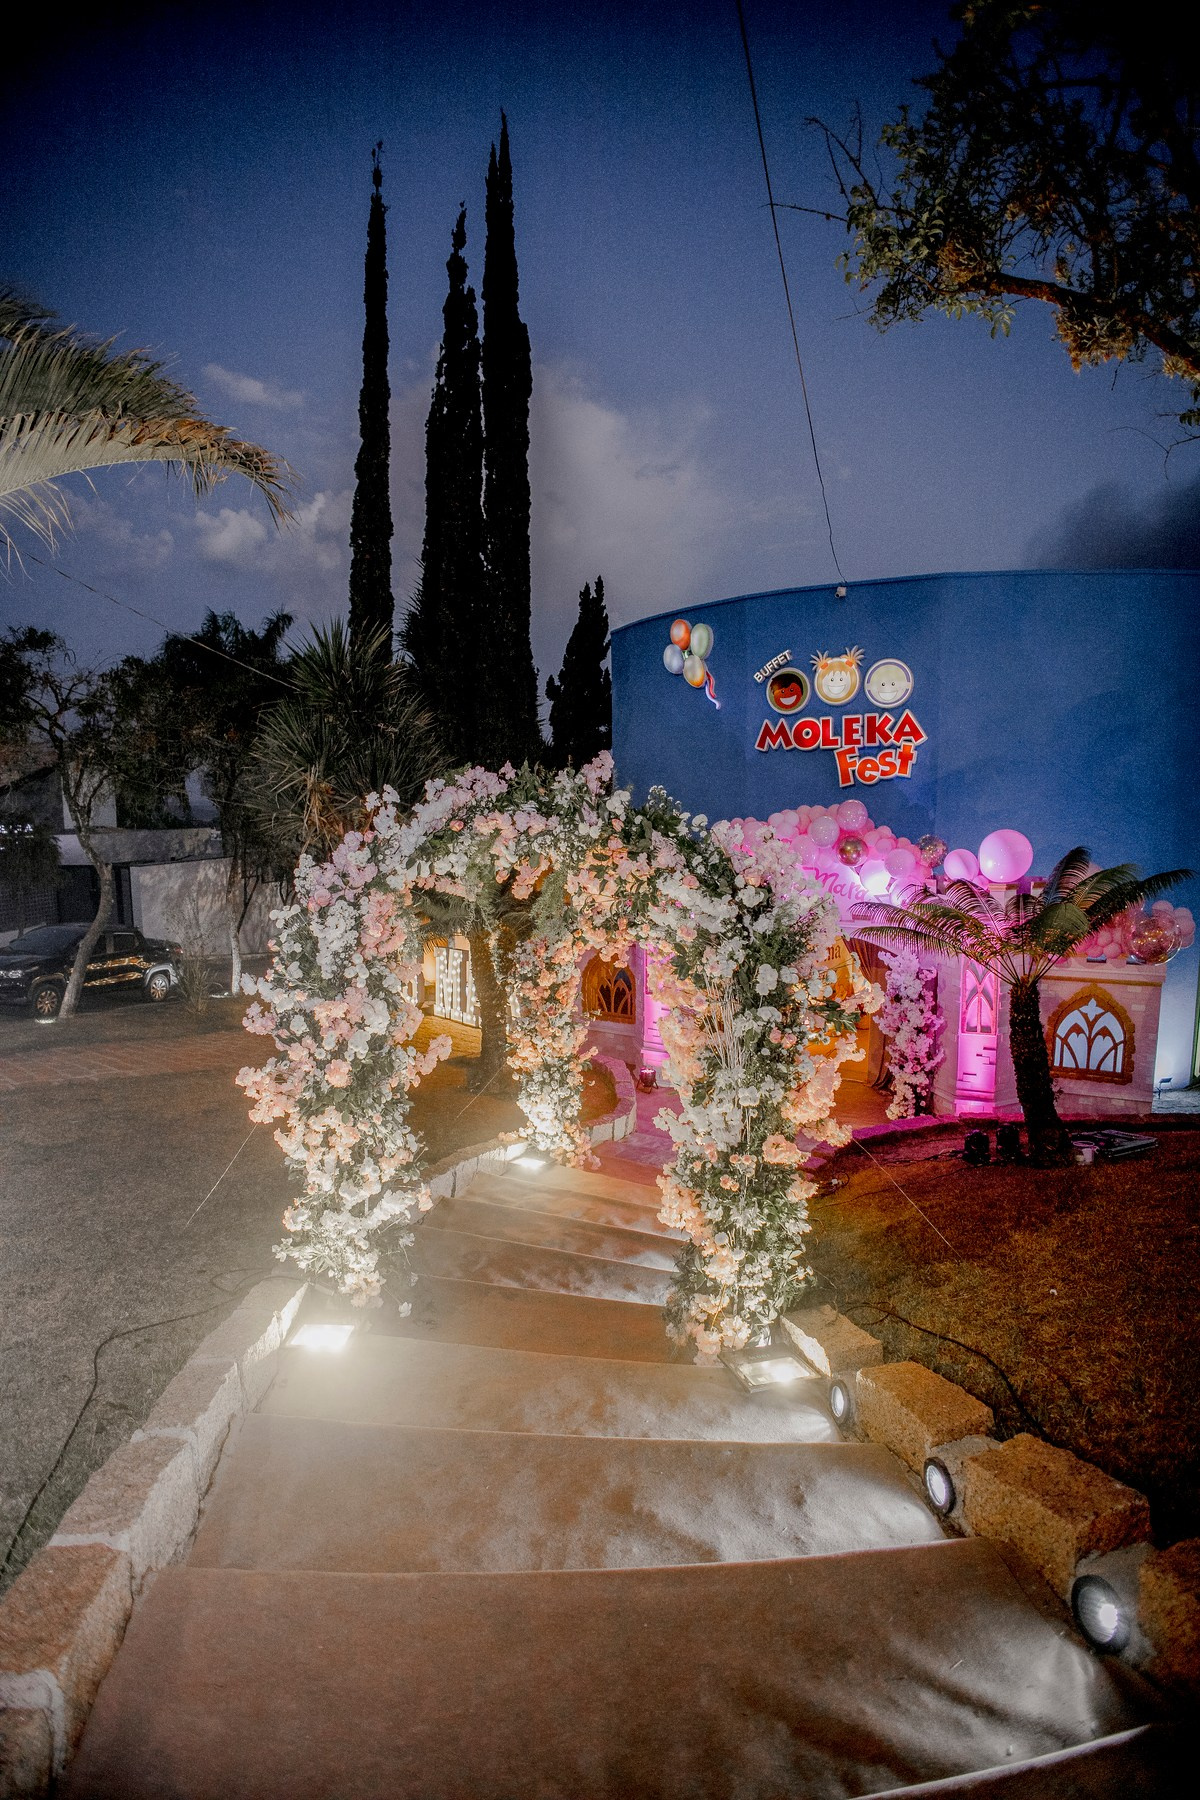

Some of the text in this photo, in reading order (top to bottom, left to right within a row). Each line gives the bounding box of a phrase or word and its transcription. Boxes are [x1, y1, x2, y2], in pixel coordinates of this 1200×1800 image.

[753, 650, 792, 683] BUFFET
[755, 709, 928, 752] MOLEKA
[834, 742, 917, 787] Fest
